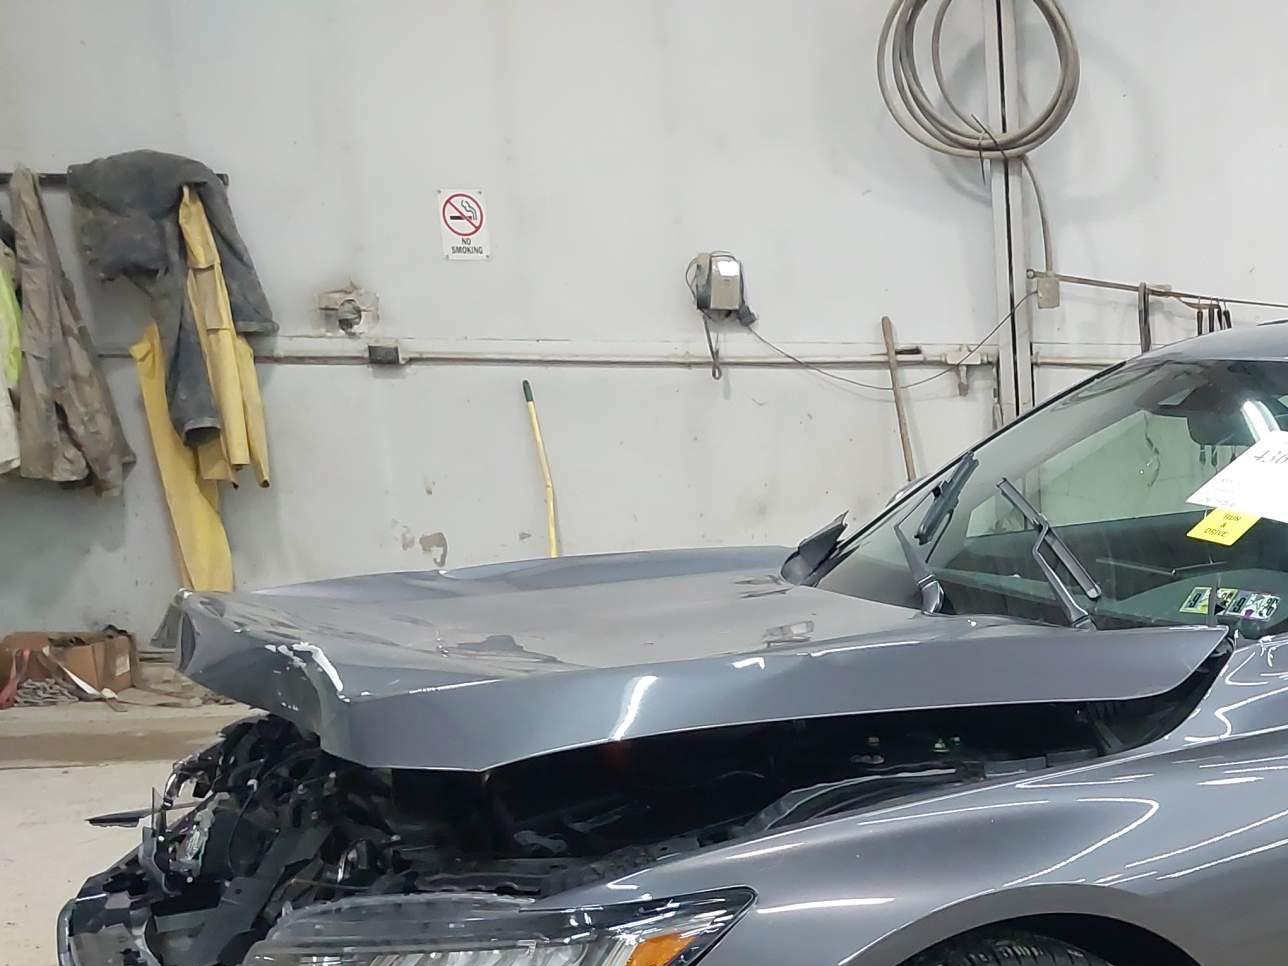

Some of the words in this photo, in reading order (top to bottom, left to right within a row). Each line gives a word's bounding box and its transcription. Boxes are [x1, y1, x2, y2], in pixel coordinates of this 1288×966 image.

[451, 246, 483, 254] SMOKING
[1223, 513, 1242, 521] RUN
[1204, 527, 1229, 537] DRIVE
